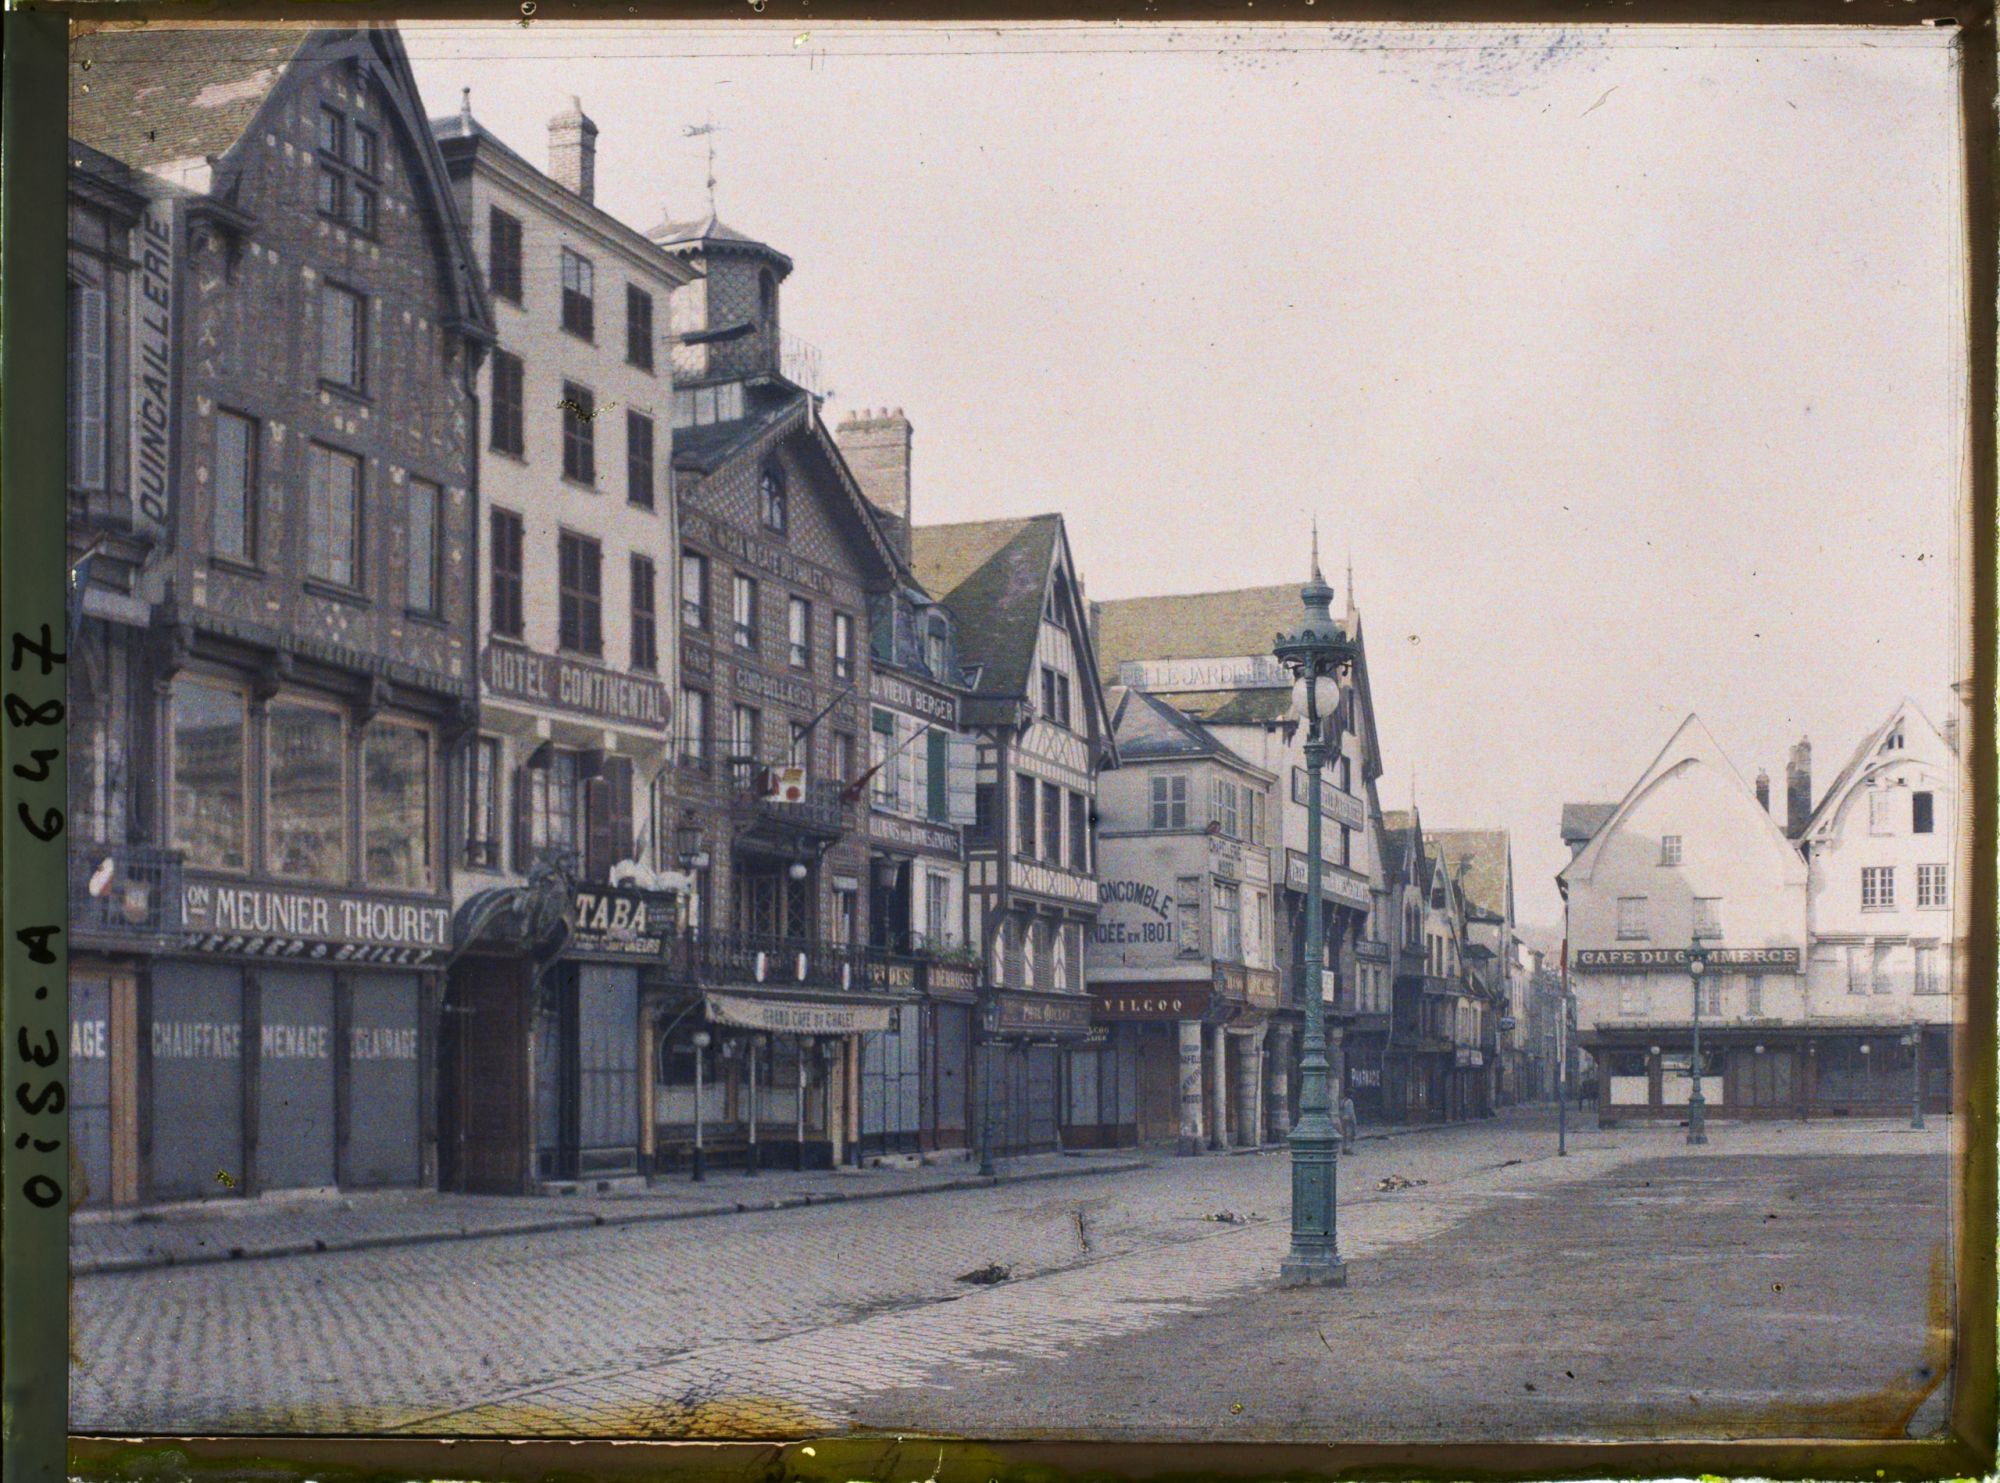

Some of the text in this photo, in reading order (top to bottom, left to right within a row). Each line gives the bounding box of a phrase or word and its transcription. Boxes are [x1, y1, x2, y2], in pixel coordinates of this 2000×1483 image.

[139, 211, 172, 525] QUINCAILLERIE
[491, 649, 666, 723] HOTEL CONTINENTAL
[215, 887, 329, 936] MEUNIER
[340, 901, 449, 945] THOURET
[1142, 922, 1172, 943] 1801
[1641, 951, 1669, 964] DU
[1674, 950, 1798, 964] CMMERCE
[152, 1023, 242, 1058] CHAUFFAGE
